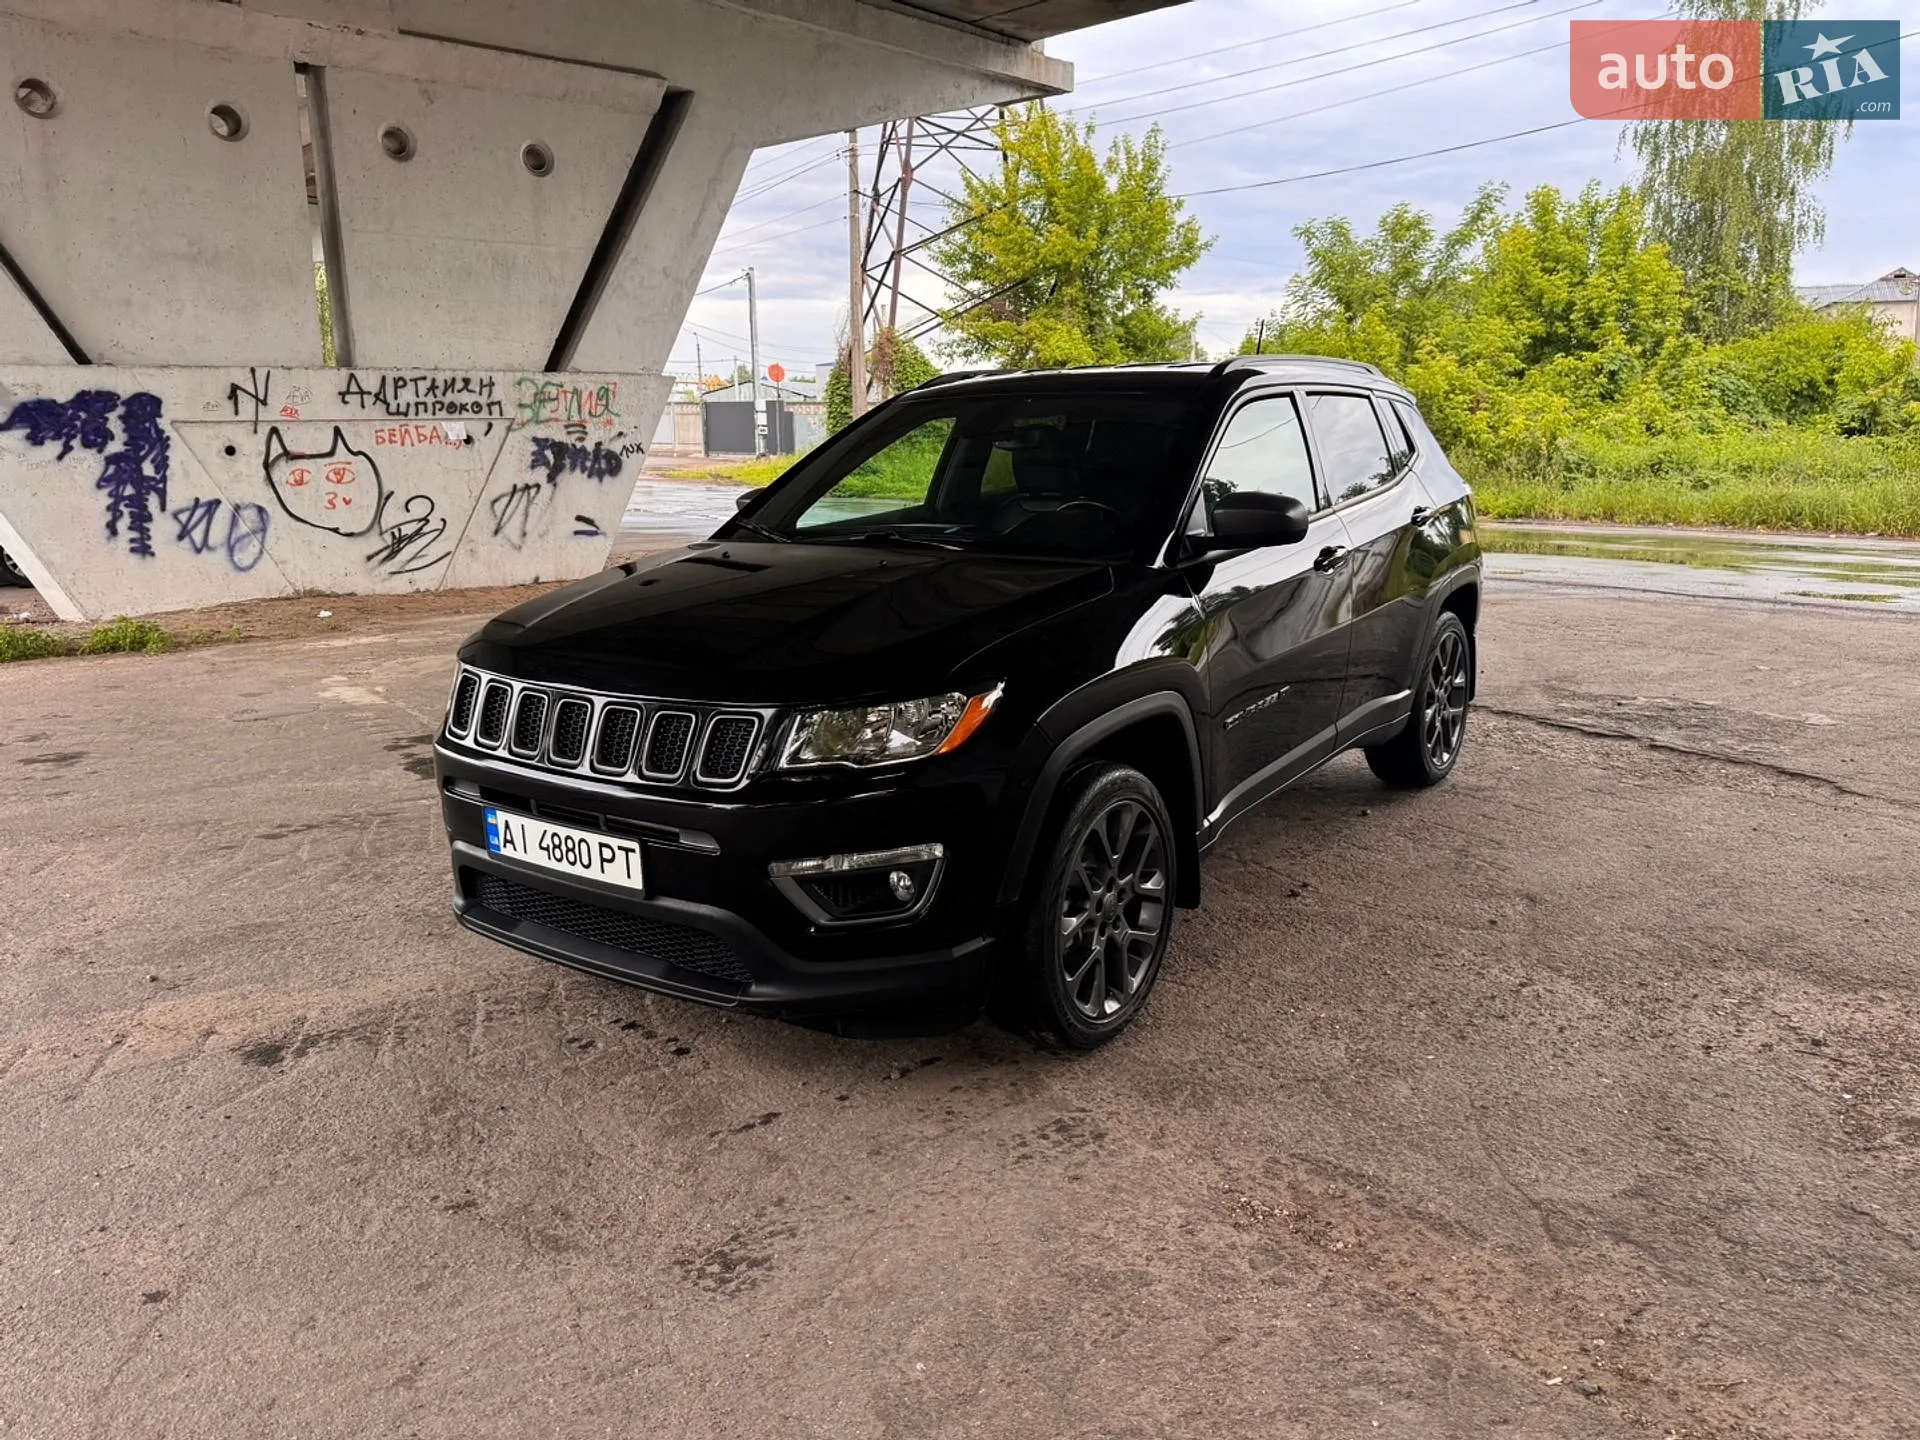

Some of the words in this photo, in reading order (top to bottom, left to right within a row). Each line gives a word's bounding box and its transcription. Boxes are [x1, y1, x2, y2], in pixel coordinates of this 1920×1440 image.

[502, 819, 528, 854] AI
[538, 829, 592, 870] 4880
[598, 841, 636, 880] PT
